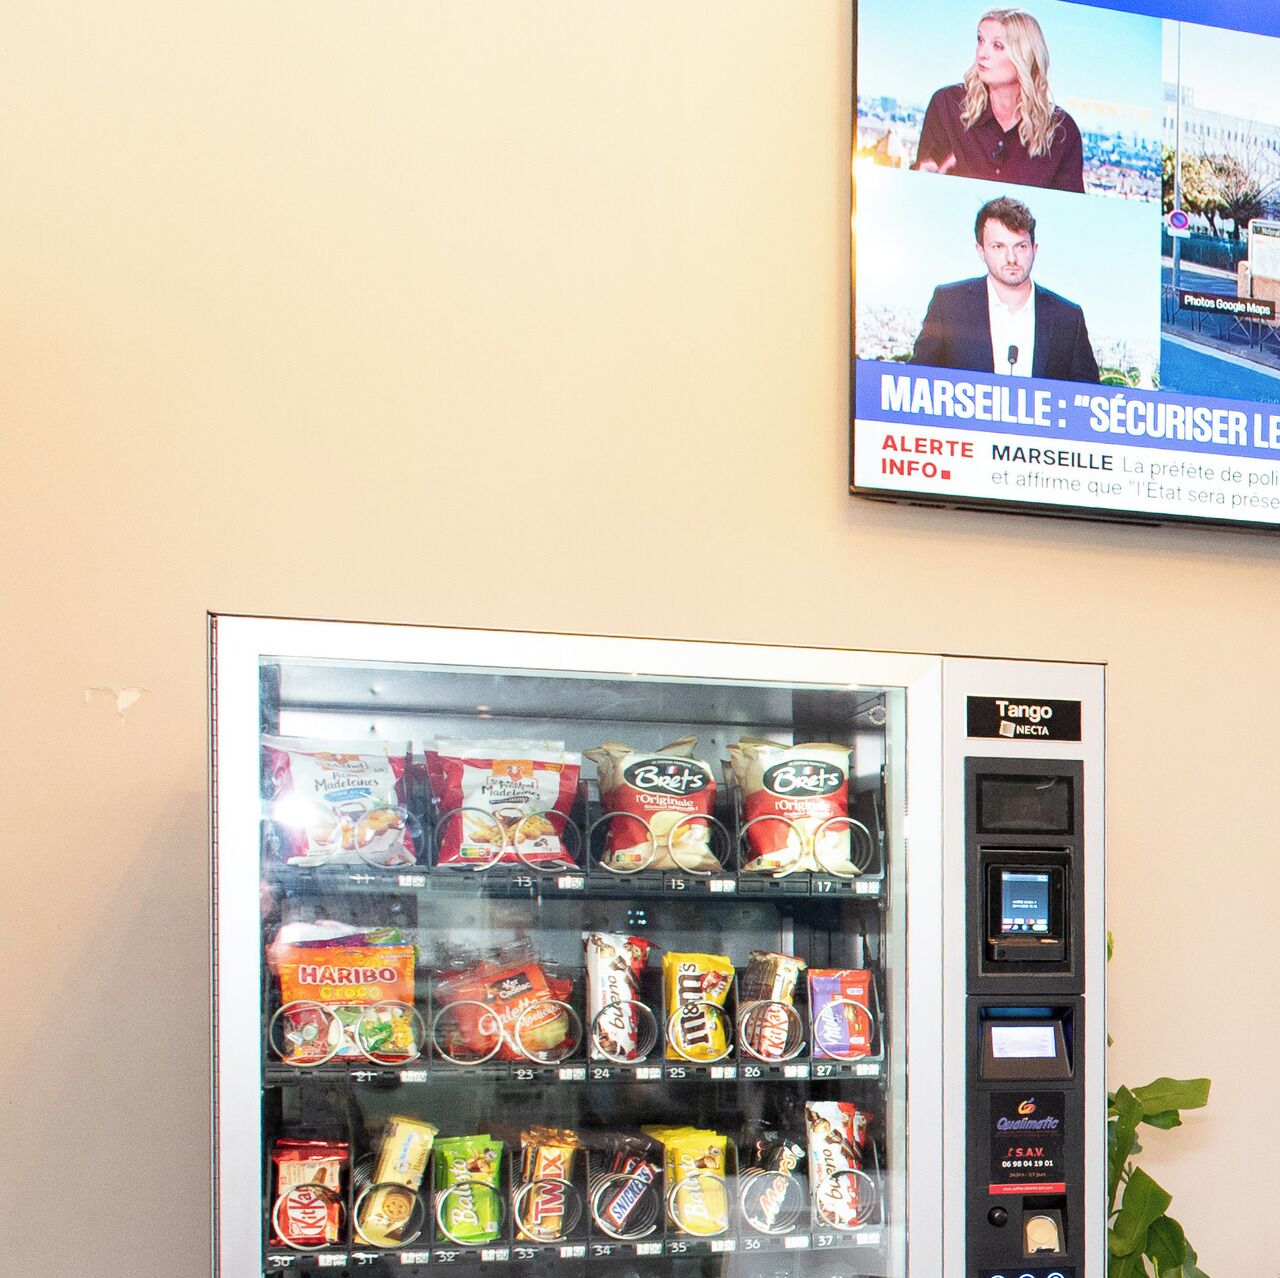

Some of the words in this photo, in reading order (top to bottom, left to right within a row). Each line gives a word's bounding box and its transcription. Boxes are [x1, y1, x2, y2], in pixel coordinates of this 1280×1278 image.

[1184, 295, 1215, 309] Photos
[1216, 298, 1246, 313] Google
[1247, 302, 1271, 316] Maps
[881, 374, 1051, 427] MARSEILLE
[1074, 394, 1247, 443] "SÉCURISER
[882, 434, 975, 458] ALERTE
[992, 445, 1113, 471] MARSEILLE
[1123, 457, 1145, 475] La
[1150, 459, 1215, 486] préfète
[1220, 465, 1243, 484] de
[992, 471, 1009, 486] et
[1017, 472, 1081, 493] affirme
[1088, 480, 1123, 499] que
[1187, 487, 1226, 506] sera
[996, 700, 1053, 723] Tango
[1016, 724, 1049, 736] NECTA
[314, 778, 379, 791] Madeleines
[635, 765, 703, 794] Brets
[773, 766, 839, 793] Brets
[481, 786, 541, 800] Madeleines
[517, 876, 532, 887] 13
[671, 878, 686, 890] 15
[817, 881, 832, 893] 17
[298, 964, 398, 985] HARIBO
[357, 1071, 372, 1082] 21
[517, 1069, 533, 1080] 23
[594, 1067, 610, 1078] 24
[670, 1067, 686, 1078] 25
[745, 1066, 761, 1077] 26
[817, 1065, 832, 1076] 27
[996, 1116, 1060, 1131] Qualimatic
[1015, 1147, 1045, 1158] S.A.V.
[1002, 1160, 1011, 1168] 06
[1012, 1160, 1022, 1168] 98
[1023, 1160, 1032, 1168] 04
[1034, 1160, 1043, 1168] 19
[450, 1156, 479, 1226] Balisto
[533, 1153, 565, 1225] TWIX
[610, 1166, 653, 1224] SNICKERS
[745, 1239, 760, 1250] 36
[818, 1235, 833, 1246] 37
[595, 1246, 611, 1256] 34
[671, 1241, 687, 1253] 35
[439, 1252, 455, 1262] 32
[518, 1248, 535, 1259] 33
